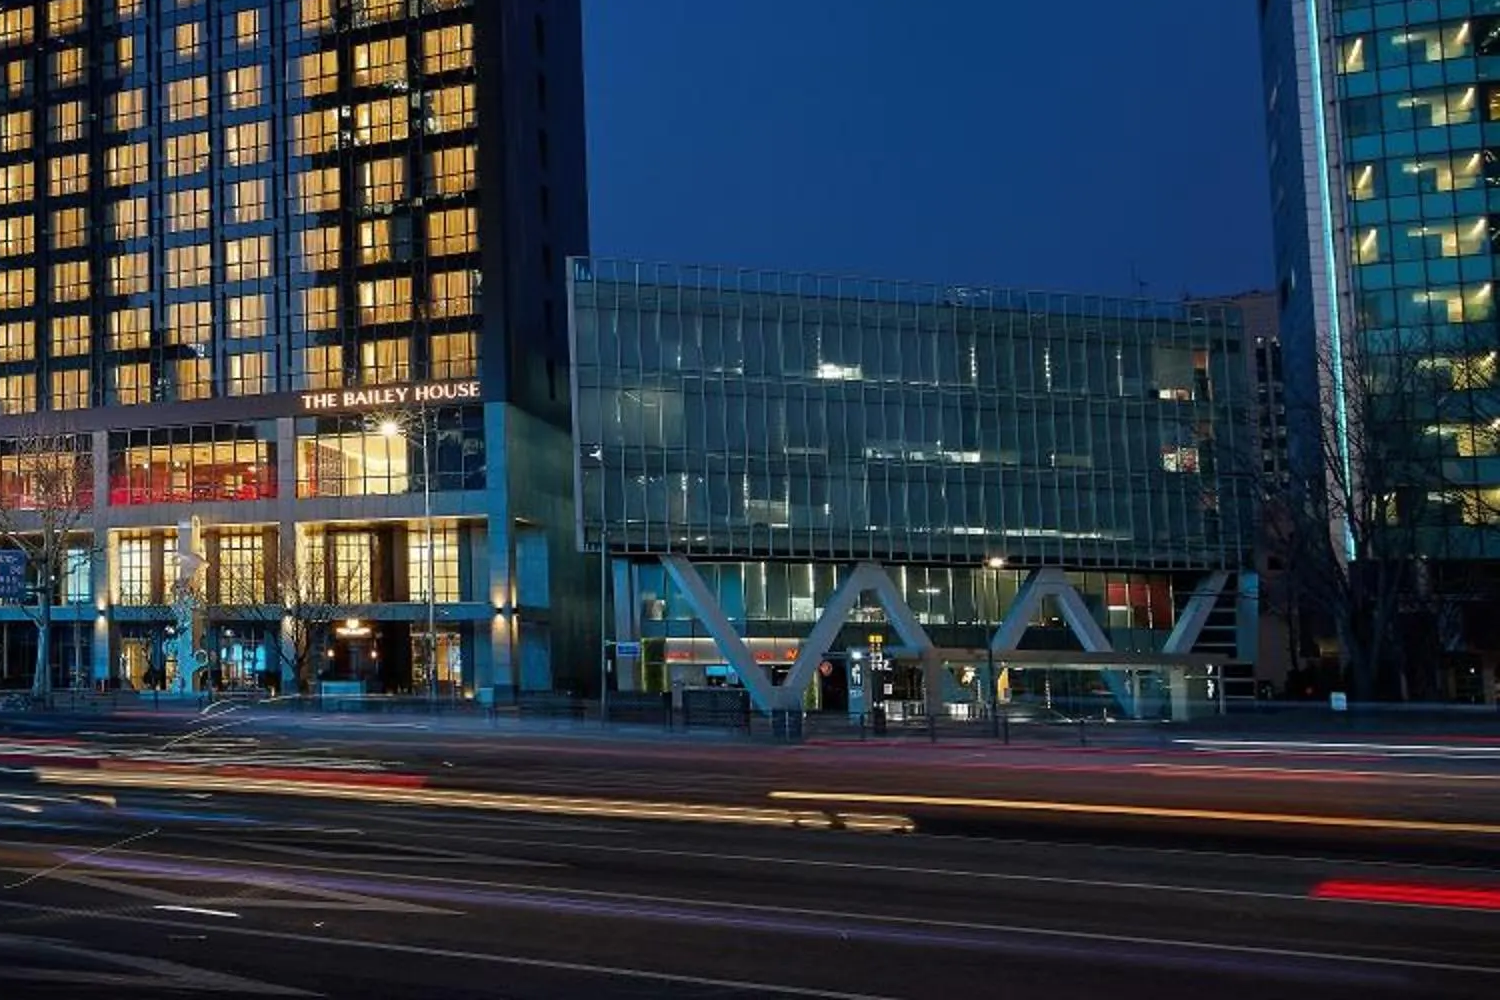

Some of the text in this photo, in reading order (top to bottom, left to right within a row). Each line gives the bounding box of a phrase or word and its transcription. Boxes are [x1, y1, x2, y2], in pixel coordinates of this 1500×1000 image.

[301, 381, 482, 410] THE BAILEY HOUSE
